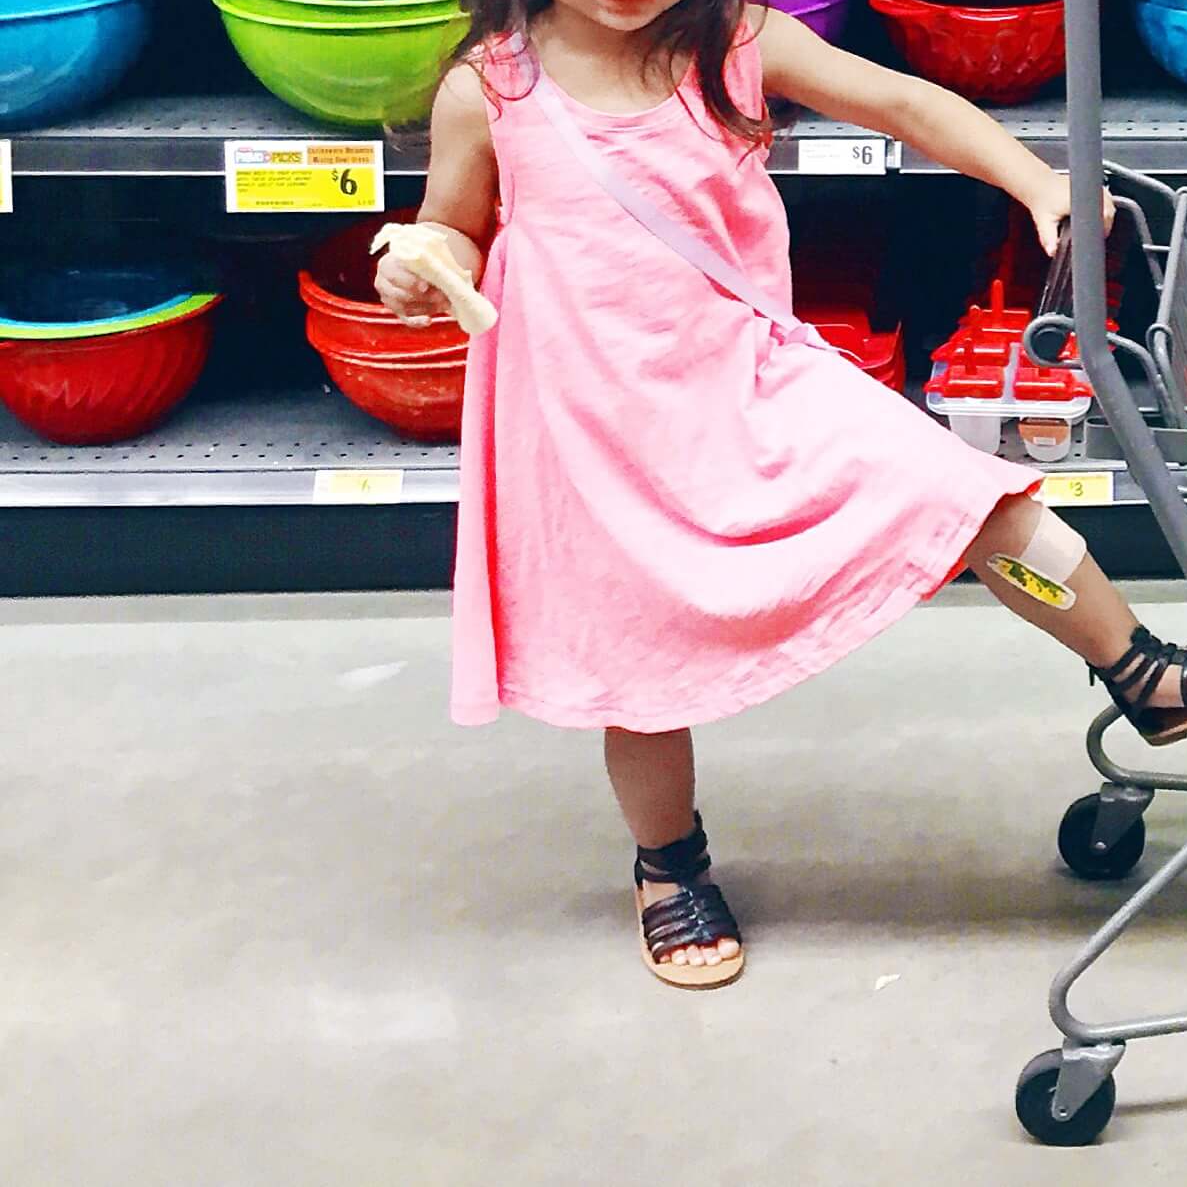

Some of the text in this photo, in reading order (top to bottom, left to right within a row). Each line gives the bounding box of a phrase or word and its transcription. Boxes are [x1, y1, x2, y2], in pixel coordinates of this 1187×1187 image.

[272, 151, 302, 163] PICKS
[852, 145, 873, 165] $6
[331, 168, 358, 196] $6
